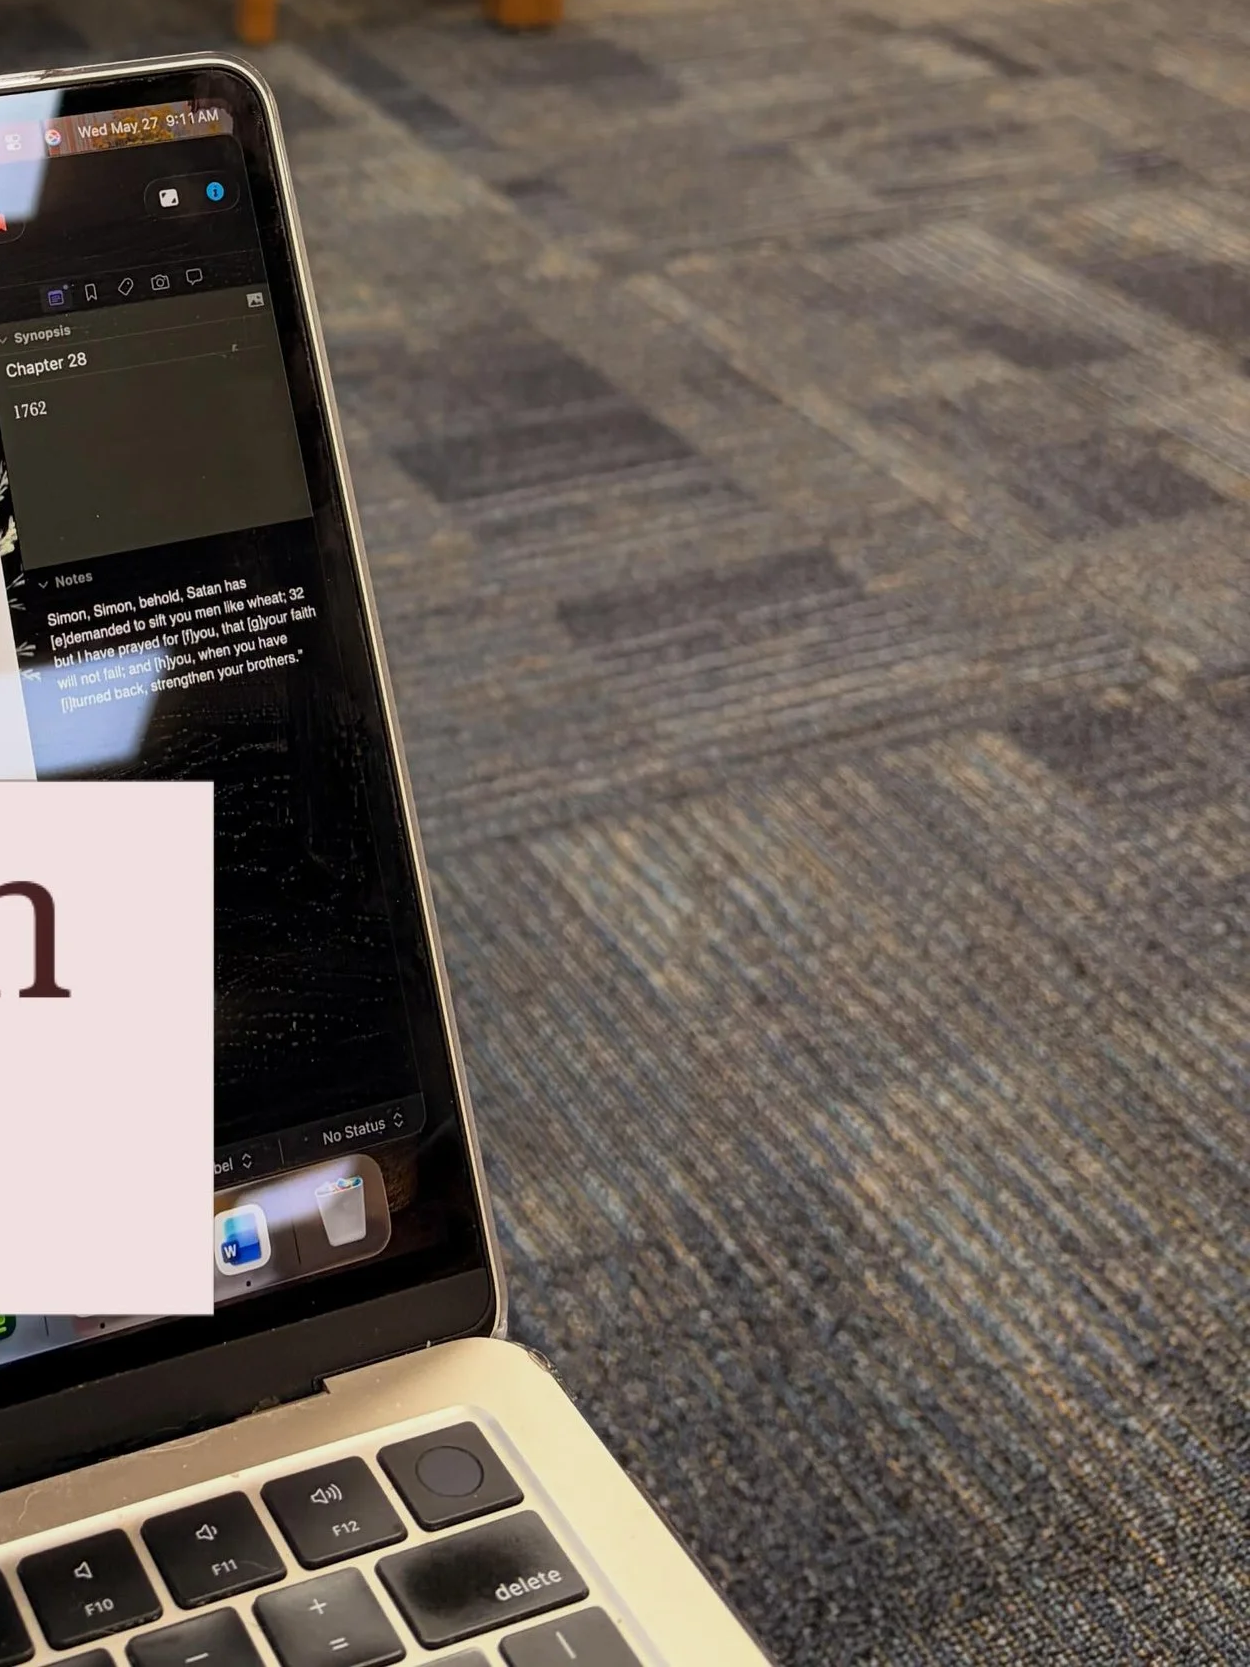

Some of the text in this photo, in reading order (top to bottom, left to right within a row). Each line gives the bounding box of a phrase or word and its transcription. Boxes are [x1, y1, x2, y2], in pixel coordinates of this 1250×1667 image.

[77, 108, 220, 139] Wed May 27 9:11 AM
[13, 324, 71, 345] Synopsis
[5, 352, 88, 378] Chapter 28
[13, 400, 48, 419] 1762
[54, 572, 93, 589] Notes
[47, 578, 247, 627] Simon, Simon, behold, Satan has
[50, 586, 305, 651] [e]demanded to sift you men like wheat; 32
[53, 605, 317, 669] but I have prayed for [f]you, that [g]your faith
[56, 634, 288, 690] will not fail; and [h]you, when you have
[1054, 617, 1104, 692] 26
[61, 688, 112, 714] [i]turned
[114, 681, 148, 700] back,
[150, 669, 215, 692] strengthen
[217, 663, 244, 681] your
[322, 1130, 343, 1146] No
[344, 1117, 387, 1140] Status
[331, 1520, 361, 1538] F12
[211, 1557, 239, 1576] F11
[494, 1567, 563, 1602] delete
[84, 1597, 115, 1617] F10
